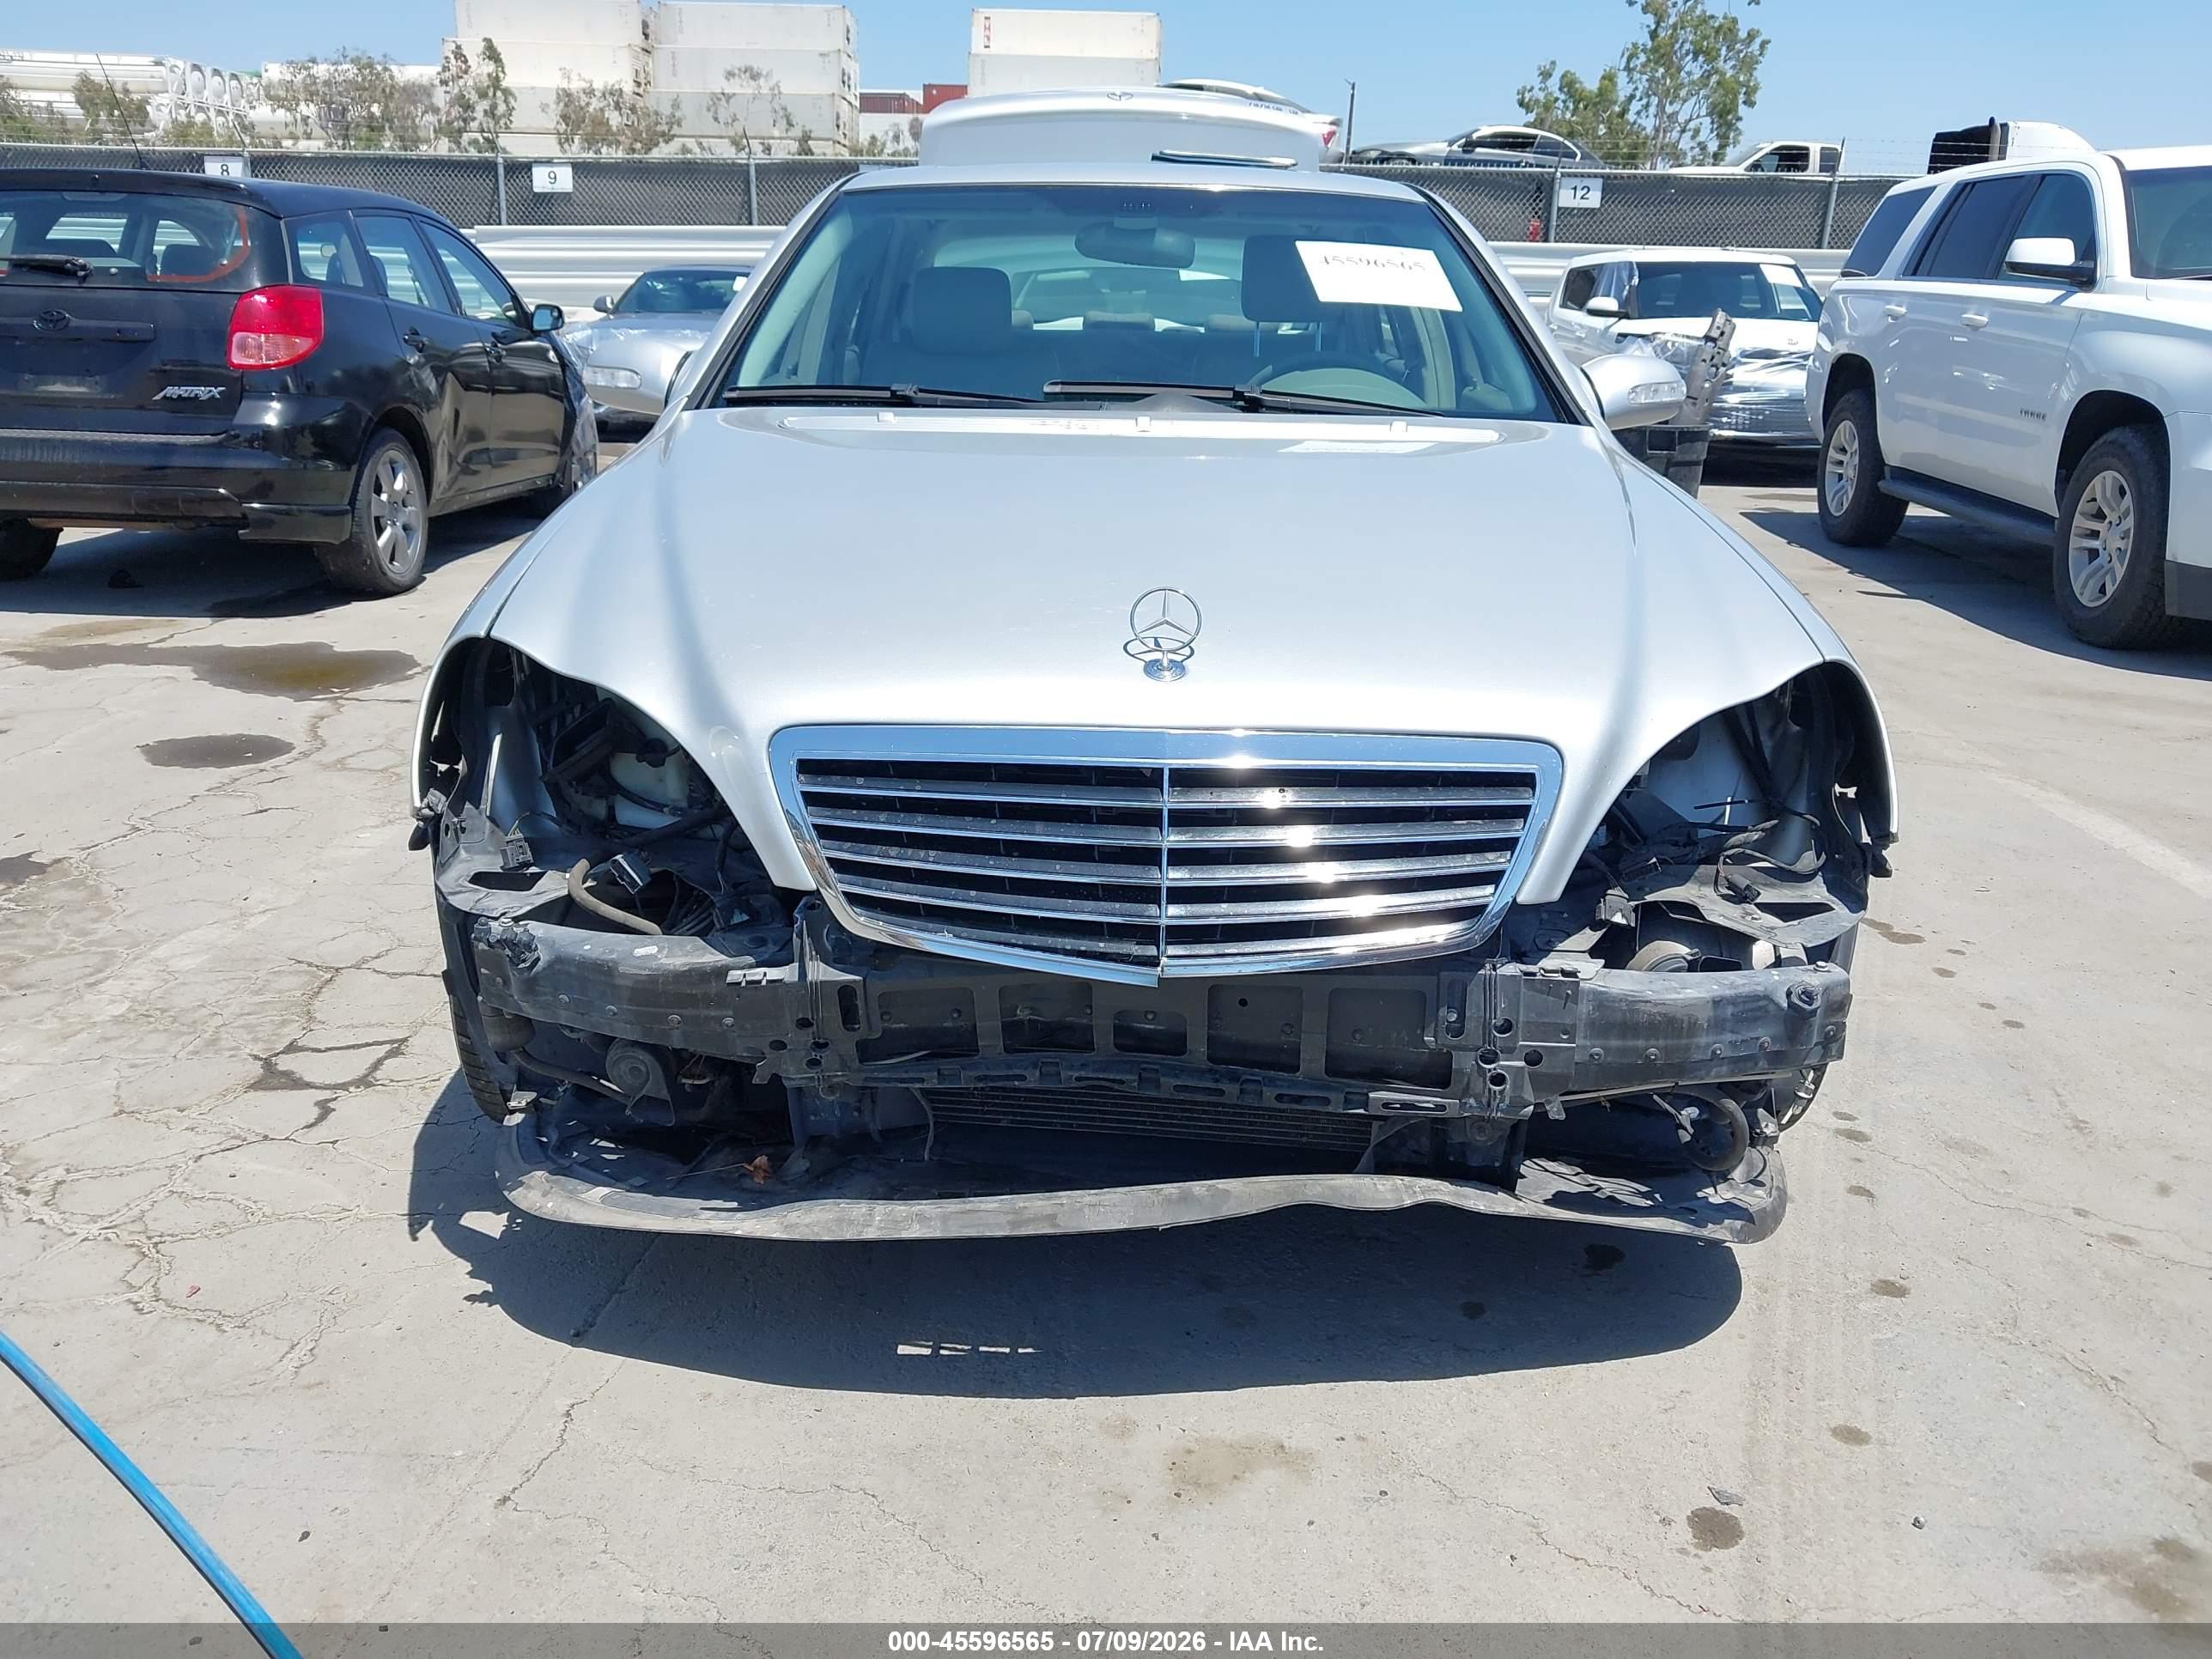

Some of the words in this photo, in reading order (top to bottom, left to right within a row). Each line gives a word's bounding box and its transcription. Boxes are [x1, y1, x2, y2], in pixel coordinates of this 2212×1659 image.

[221, 163, 230, 177] 8
[548, 170, 557, 185] 9
[1571, 185, 1591, 200] 12
[152, 386, 226, 400] MATRIX
